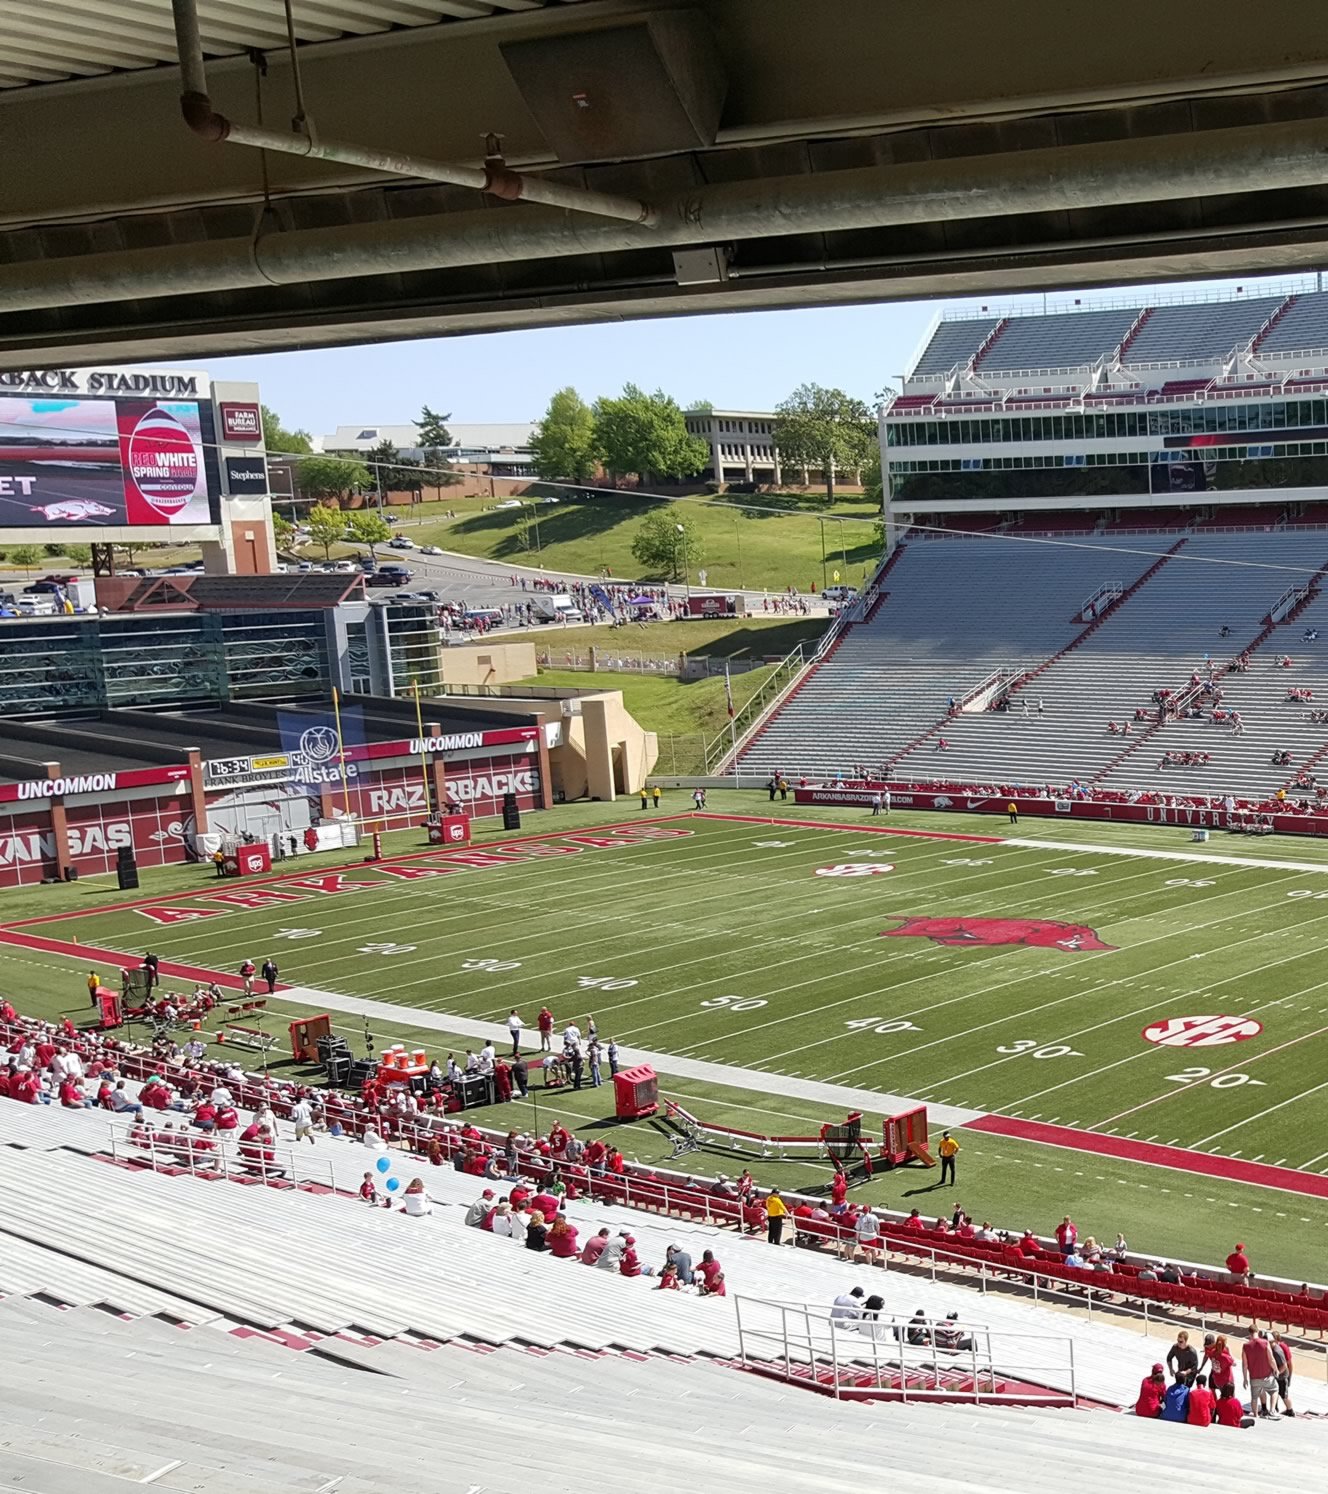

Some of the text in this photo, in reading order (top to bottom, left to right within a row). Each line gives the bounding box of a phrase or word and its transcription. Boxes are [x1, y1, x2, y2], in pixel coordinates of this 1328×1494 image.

[0, 371, 198, 393] BACK STADIUM
[228, 418, 256, 426] BUREAU
[234, 411, 255, 419] FARM
[134, 467, 170, 478] SPRING
[231, 470, 265, 481] Stephens
[410, 733, 483, 754] UNCOMMON
[214, 760, 249, 775] 76:34
[294, 762, 358, 784] Allstate
[18, 773, 116, 800] UNCOMMON
[205, 776, 241, 788] FRANK
[241, 770, 287, 783] BROYLES
[133, 827, 695, 924] ARKANSAS
[359, 942, 417, 956] 20
[462, 958, 523, 972] 30
[578, 975, 639, 991] 40
[700, 994, 769, 1012] 50
[844, 1016, 912, 1034] 40
[1144, 1015, 1261, 1047] SEC
[996, 1039, 1072, 1059] 30
[1164, 1067, 1250, 1089] 20
